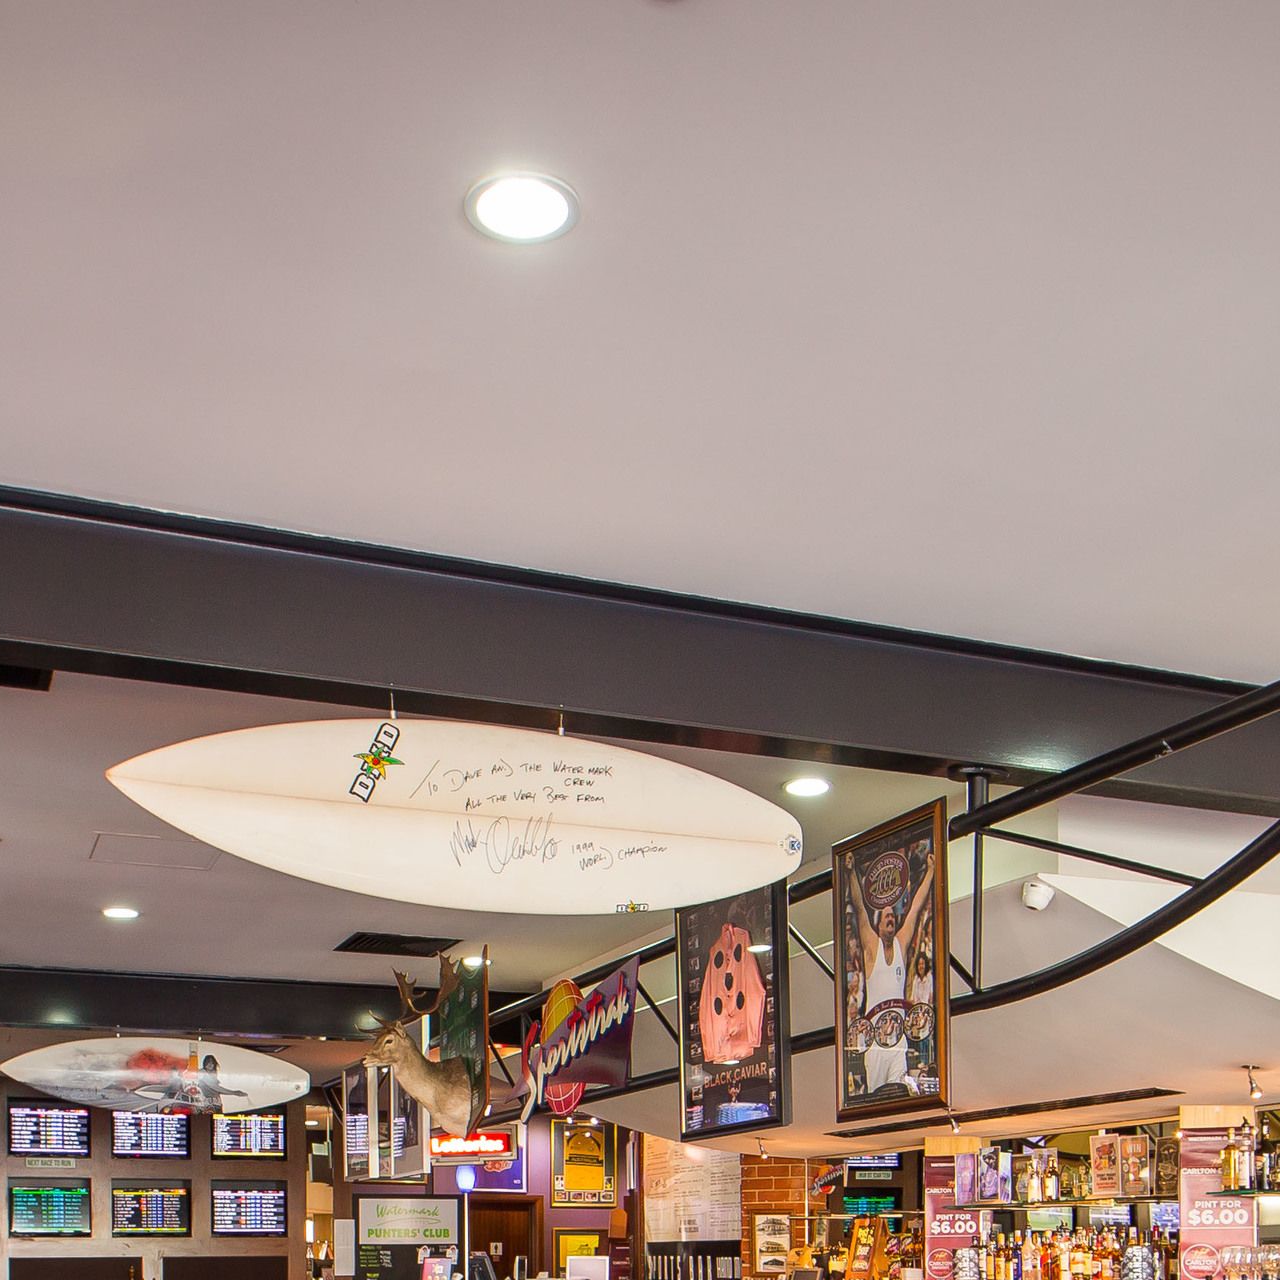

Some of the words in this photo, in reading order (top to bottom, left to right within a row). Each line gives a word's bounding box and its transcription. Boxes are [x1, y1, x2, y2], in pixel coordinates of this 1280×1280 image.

[520, 763, 543, 774] THE
[563, 778, 595, 788] CREW
[576, 794, 605, 804] FROM
[704, 1070, 732, 1088] BLACK
[734, 1062, 767, 1081] CAVIAR
[431, 1135, 505, 1153] Lotteries
[1195, 1200, 1219, 1209] PINT
[1220, 1200, 1242, 1209] FOR
[376, 1203, 440, 1218] Watermark
[935, 1213, 954, 1221] PINT
[955, 1213, 972, 1221] FOR
[1188, 1209, 1249, 1226] $6.00
[367, 1228, 421, 1239] PUNTERS'
[423, 1228, 450, 1239] CLUB
[930, 1220, 978, 1236] $6.00
[1184, 1258, 1219, 1266] CARLTON
